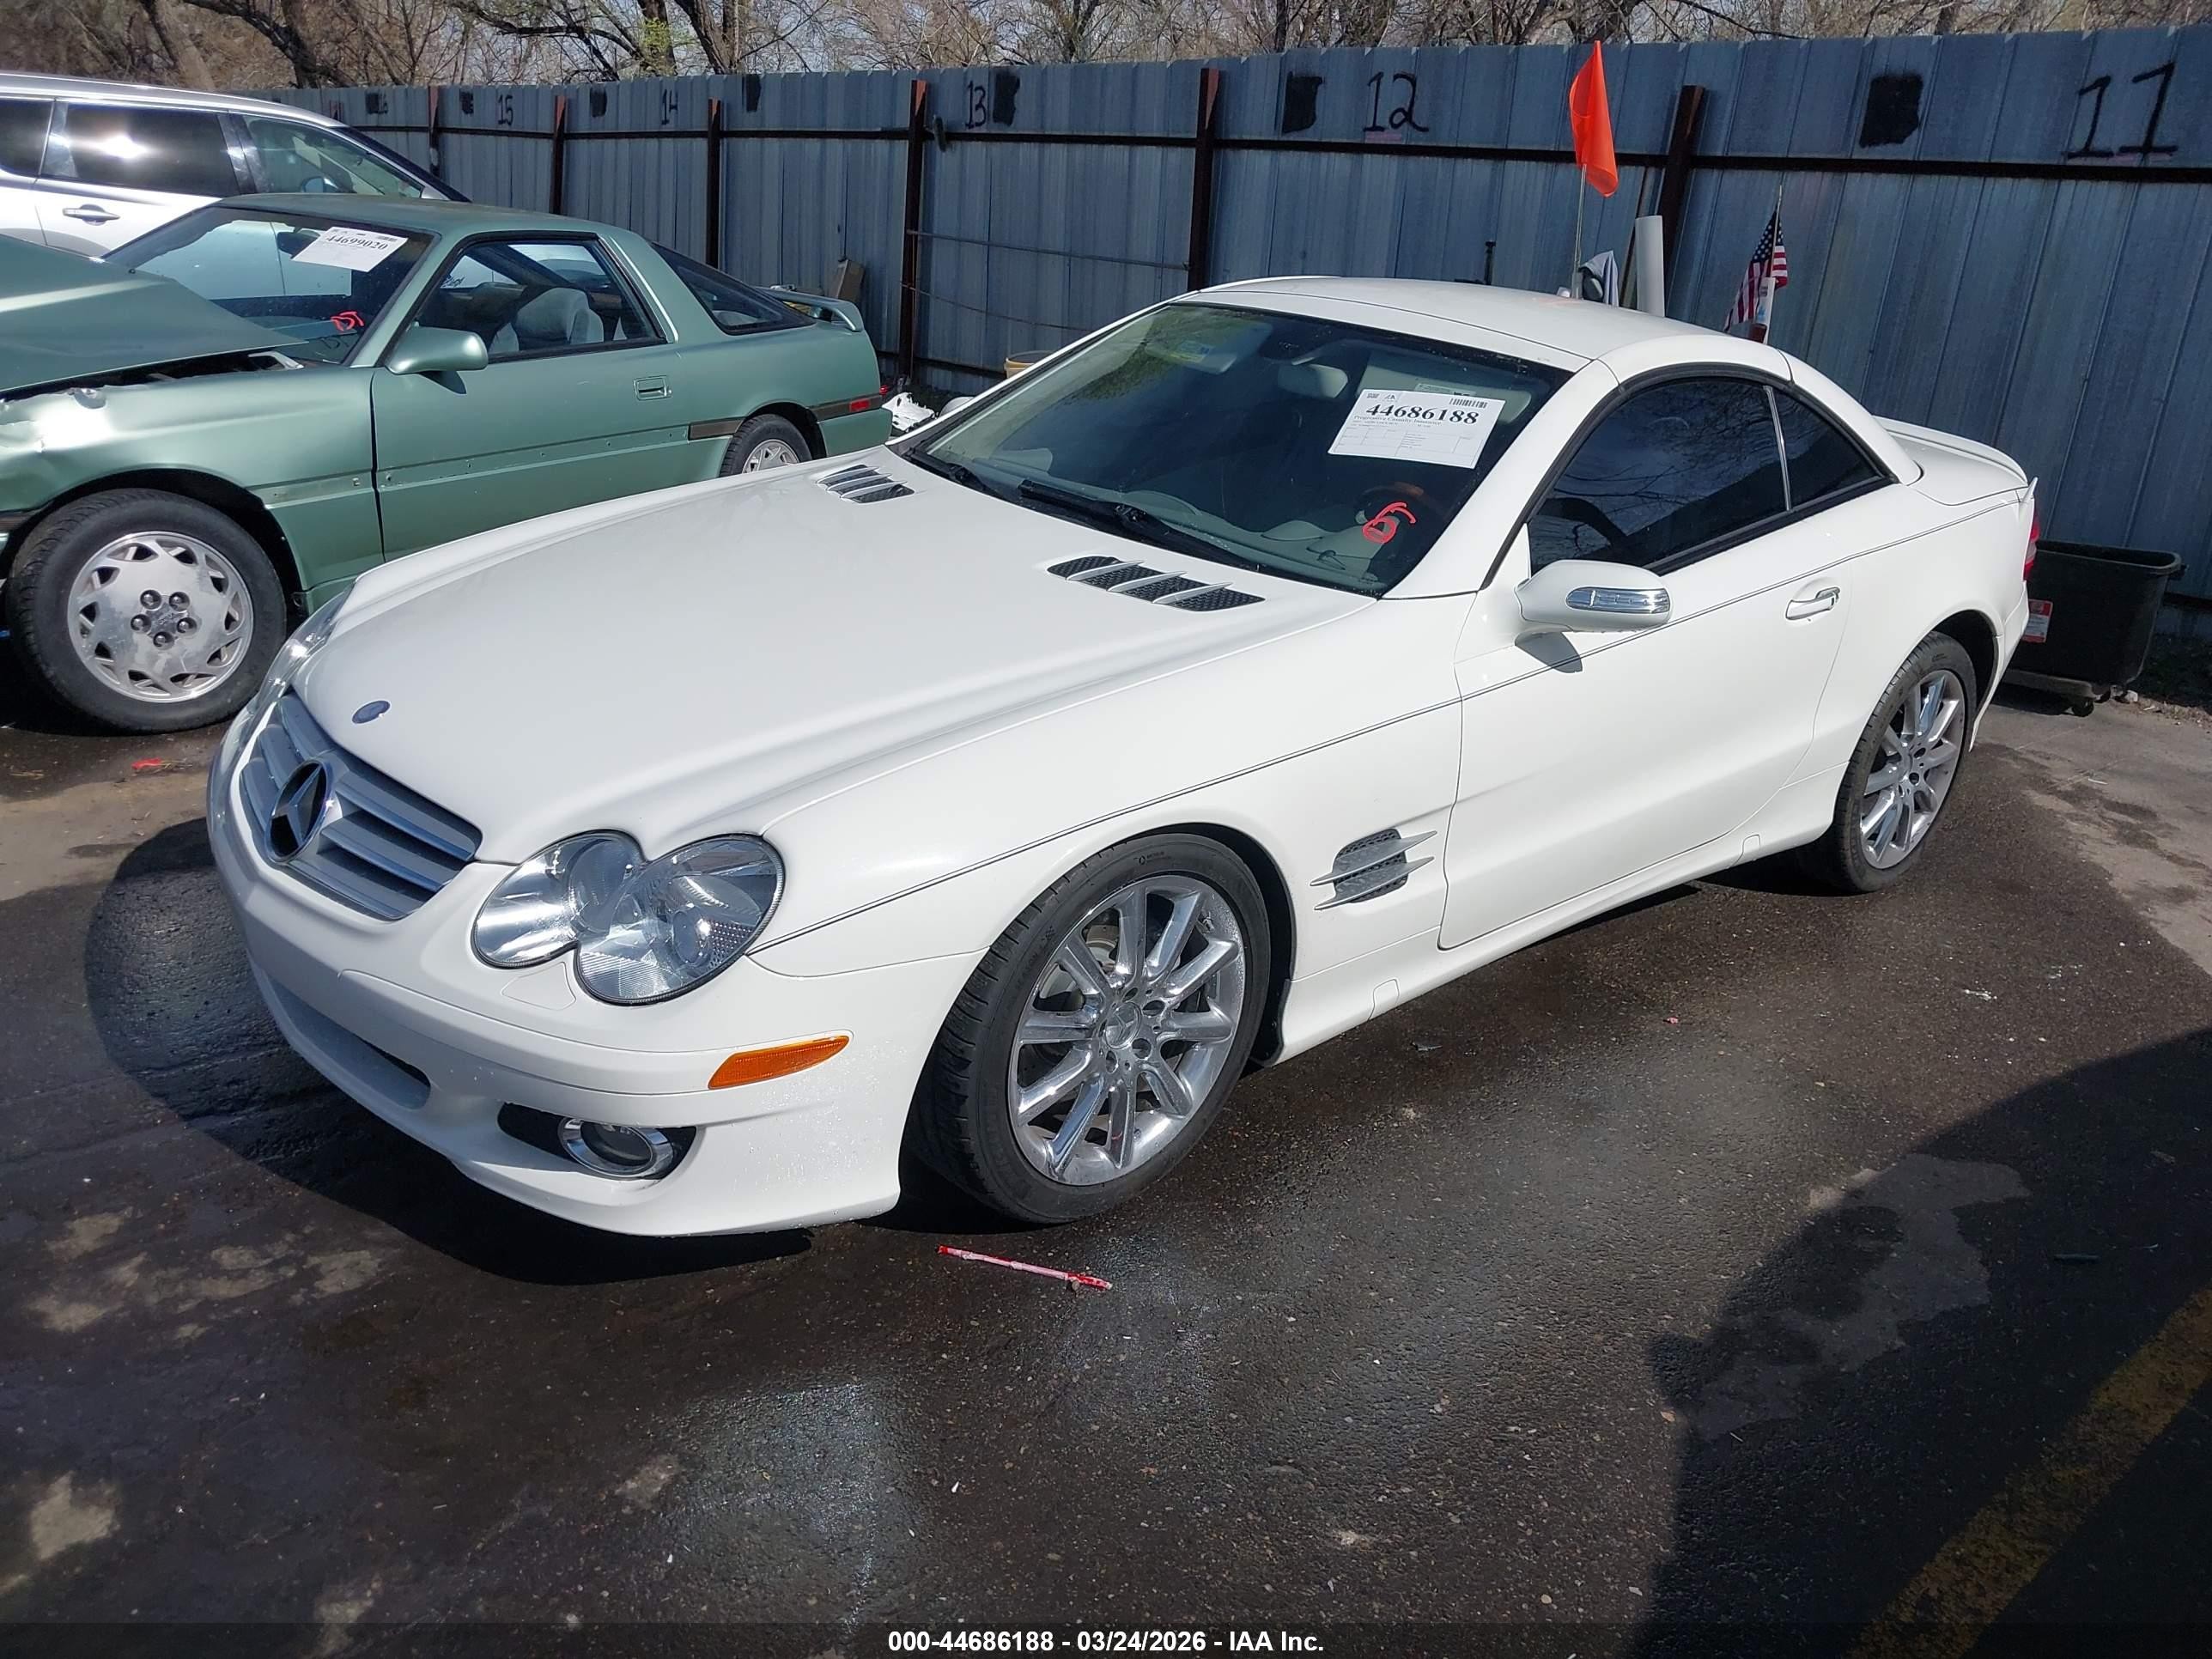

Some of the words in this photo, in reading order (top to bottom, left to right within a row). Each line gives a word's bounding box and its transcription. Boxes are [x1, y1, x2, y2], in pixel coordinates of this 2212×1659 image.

[497, 94, 514, 125] 15
[661, 88, 678, 125] 14
[965, 81, 987, 129] 13
[1363, 71, 1429, 131] 12
[2068, 60, 2179, 159] 11
[325, 234, 389, 250] 44699020
[1365, 404, 1479, 424] 44686188
